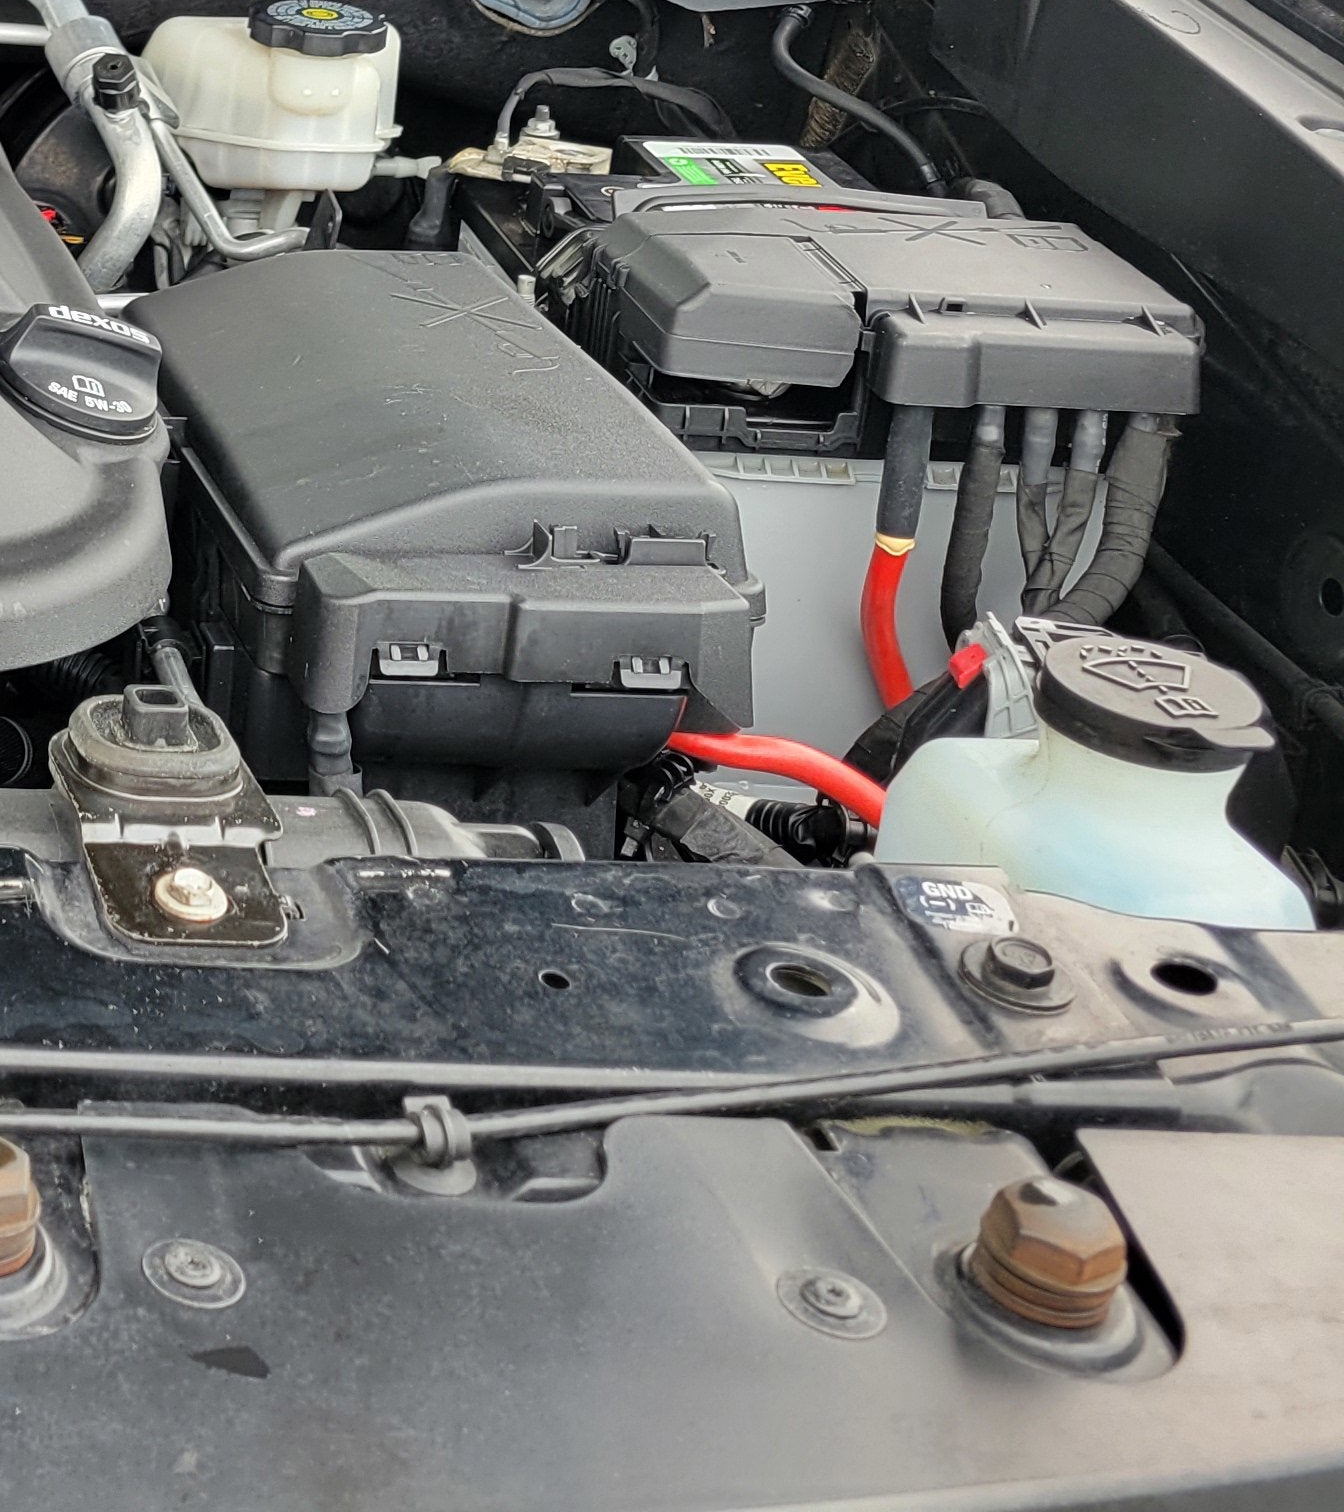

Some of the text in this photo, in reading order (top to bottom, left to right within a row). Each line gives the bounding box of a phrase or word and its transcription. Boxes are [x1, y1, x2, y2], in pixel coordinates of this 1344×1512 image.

[48, 305, 150, 344] dexos
[48, 381, 133, 413] SAE 5W-30
[921, 881, 974, 900] GND
